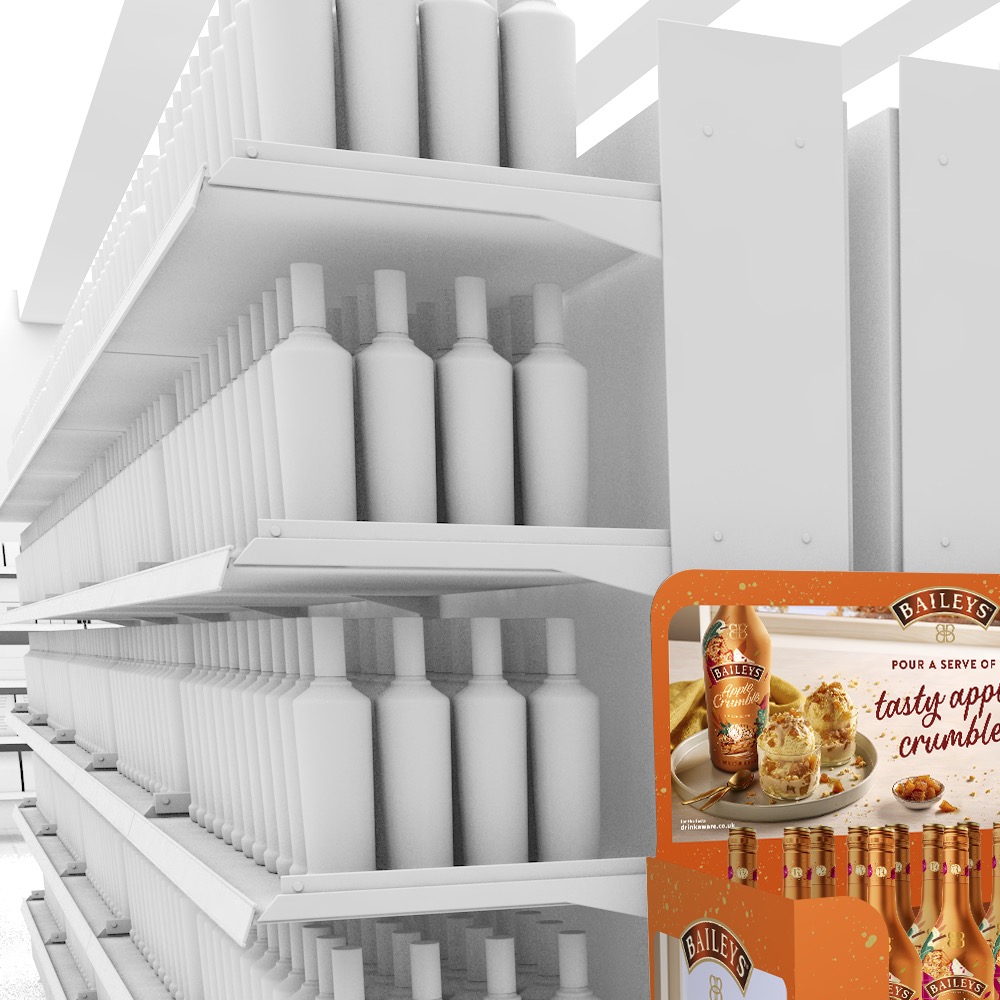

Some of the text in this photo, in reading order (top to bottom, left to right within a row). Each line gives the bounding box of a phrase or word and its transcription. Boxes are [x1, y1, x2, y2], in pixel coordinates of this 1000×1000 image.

[898, 592, 990, 620] BAILEYS
[714, 664, 762, 679] BAILEYS
[892, 658, 996, 670] POUR A SERVE OF
[721, 682, 754, 699] Apple
[713, 692, 761, 709] Crumble
[874, 684, 946, 728] tasty
[680, 822, 736, 831] drinkaware.co.uk
[685, 927, 747, 978] BAILEYS
[930, 978, 982, 995] BAILEYS
